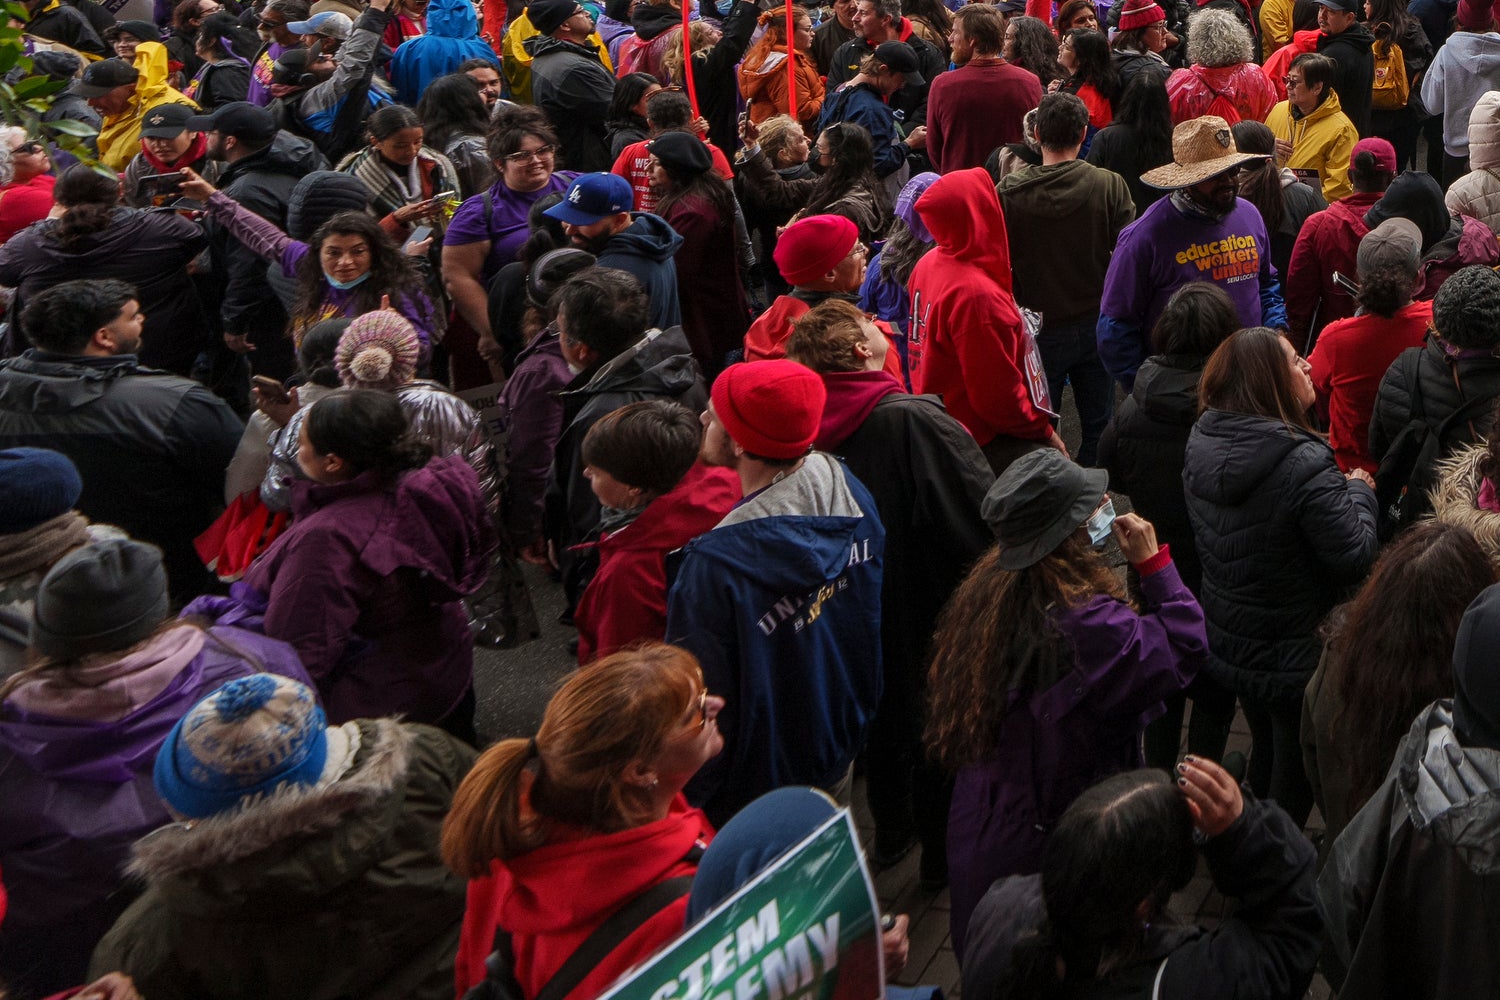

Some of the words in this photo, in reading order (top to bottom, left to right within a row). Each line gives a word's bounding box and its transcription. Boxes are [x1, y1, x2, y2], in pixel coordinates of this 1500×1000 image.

[568, 184, 581, 204] LA
[1175, 234, 1256, 264] education
[1194, 248, 1259, 272] workers
[1212, 259, 1259, 280] united
